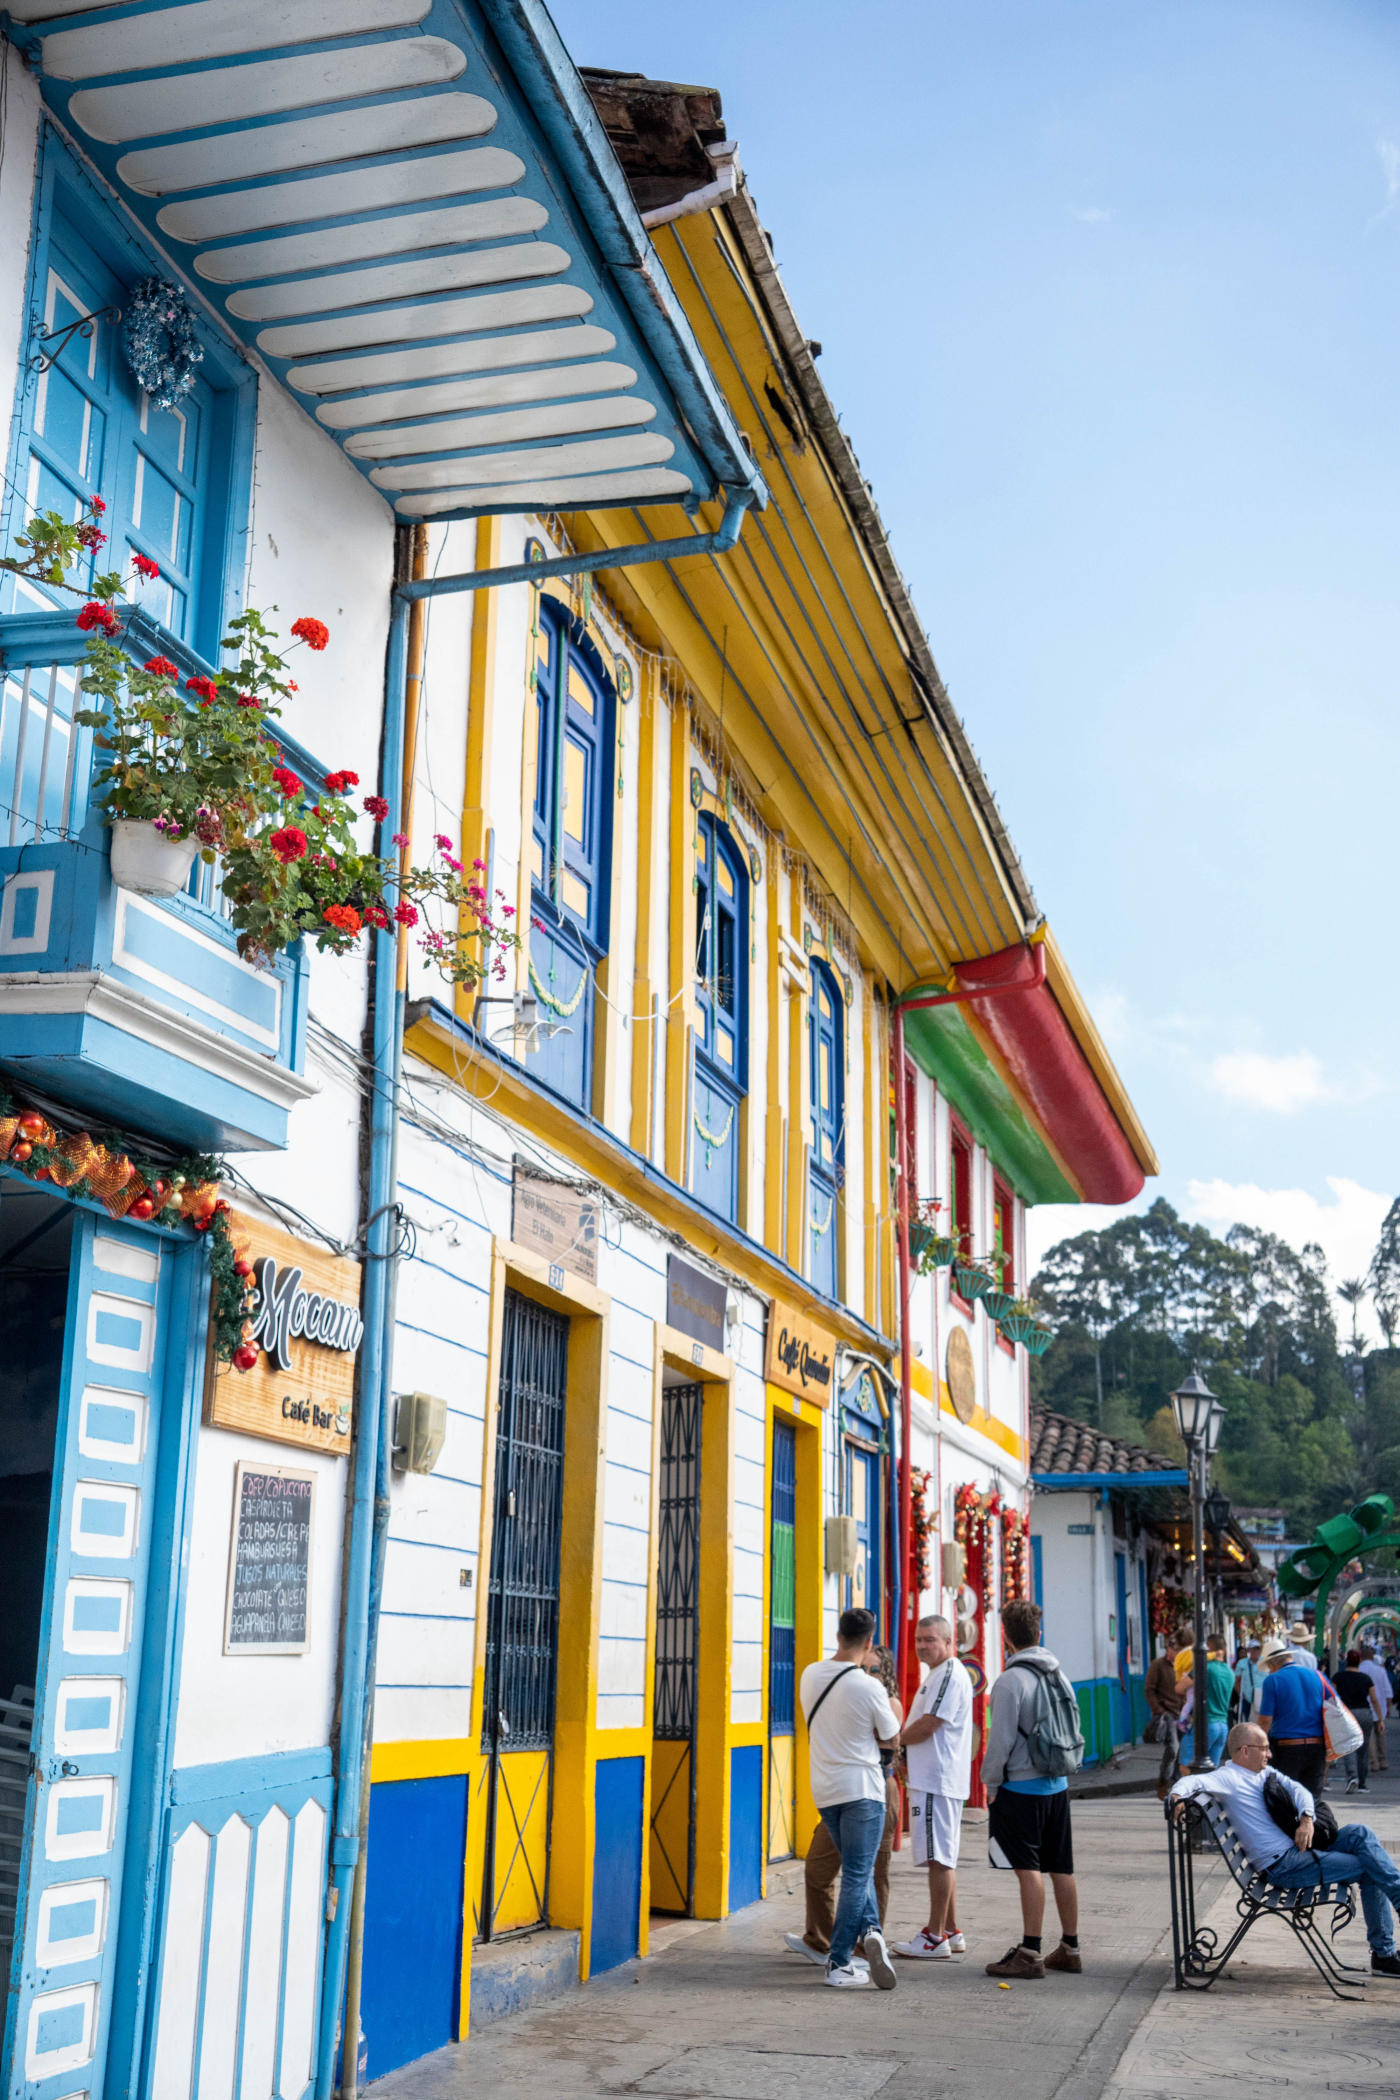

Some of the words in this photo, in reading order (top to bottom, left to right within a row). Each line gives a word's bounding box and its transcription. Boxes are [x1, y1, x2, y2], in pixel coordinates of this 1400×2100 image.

[778, 1327, 800, 1375] Café
[282, 1396, 310, 1424] Café
[312, 1404, 333, 1429] Bar
[277, 1587, 306, 1607] QUESO
